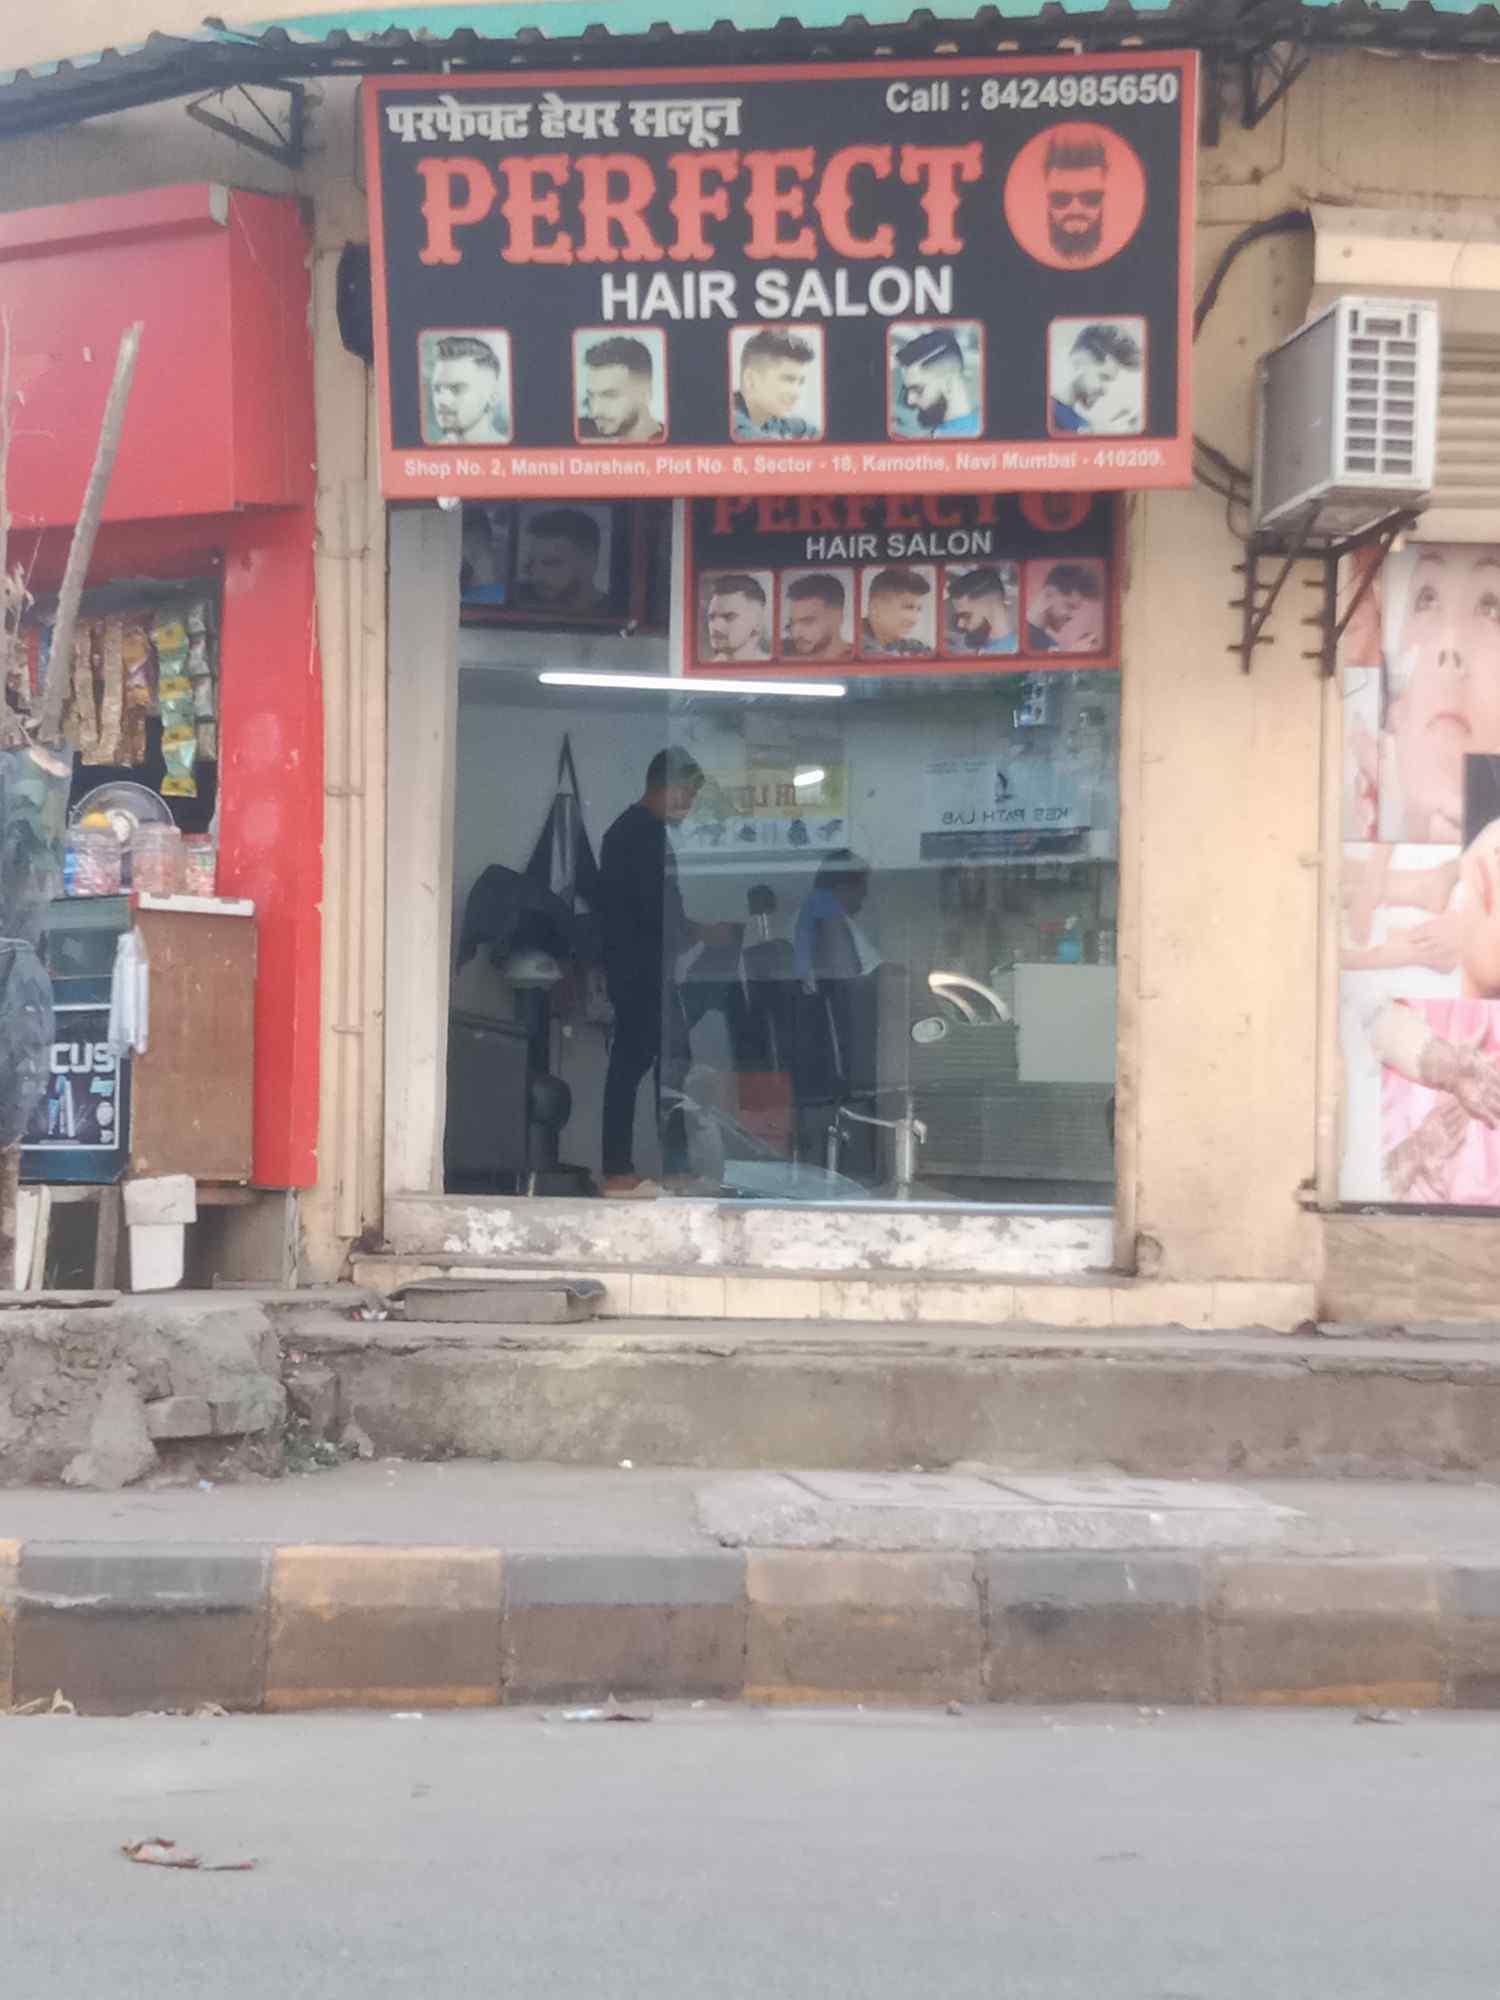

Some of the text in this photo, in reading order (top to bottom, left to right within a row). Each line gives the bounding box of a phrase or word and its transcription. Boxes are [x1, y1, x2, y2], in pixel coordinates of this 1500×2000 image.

[886, 82, 949, 113] Call
[981, 73, 1179, 111] 8424985650
[538, 92, 620, 139] हेयर
[628, 98, 742, 148] सलून
[416, 141, 984, 266] PERFECT
[602, 265, 953, 320] HAIR SALON
[404, 458, 451, 477] Shop
[490, 459, 506, 477] 2,
[570, 457, 650, 477] Darshan,
[656, 456, 691, 474] Plot
[754, 455, 814, 474] Sector
[863, 453, 950, 473] Kamothe,
[956, 452, 997, 471] Navi
[1003, 451, 1077, 470] Mumbai
[805, 530, 992, 560] HAIR SALON
